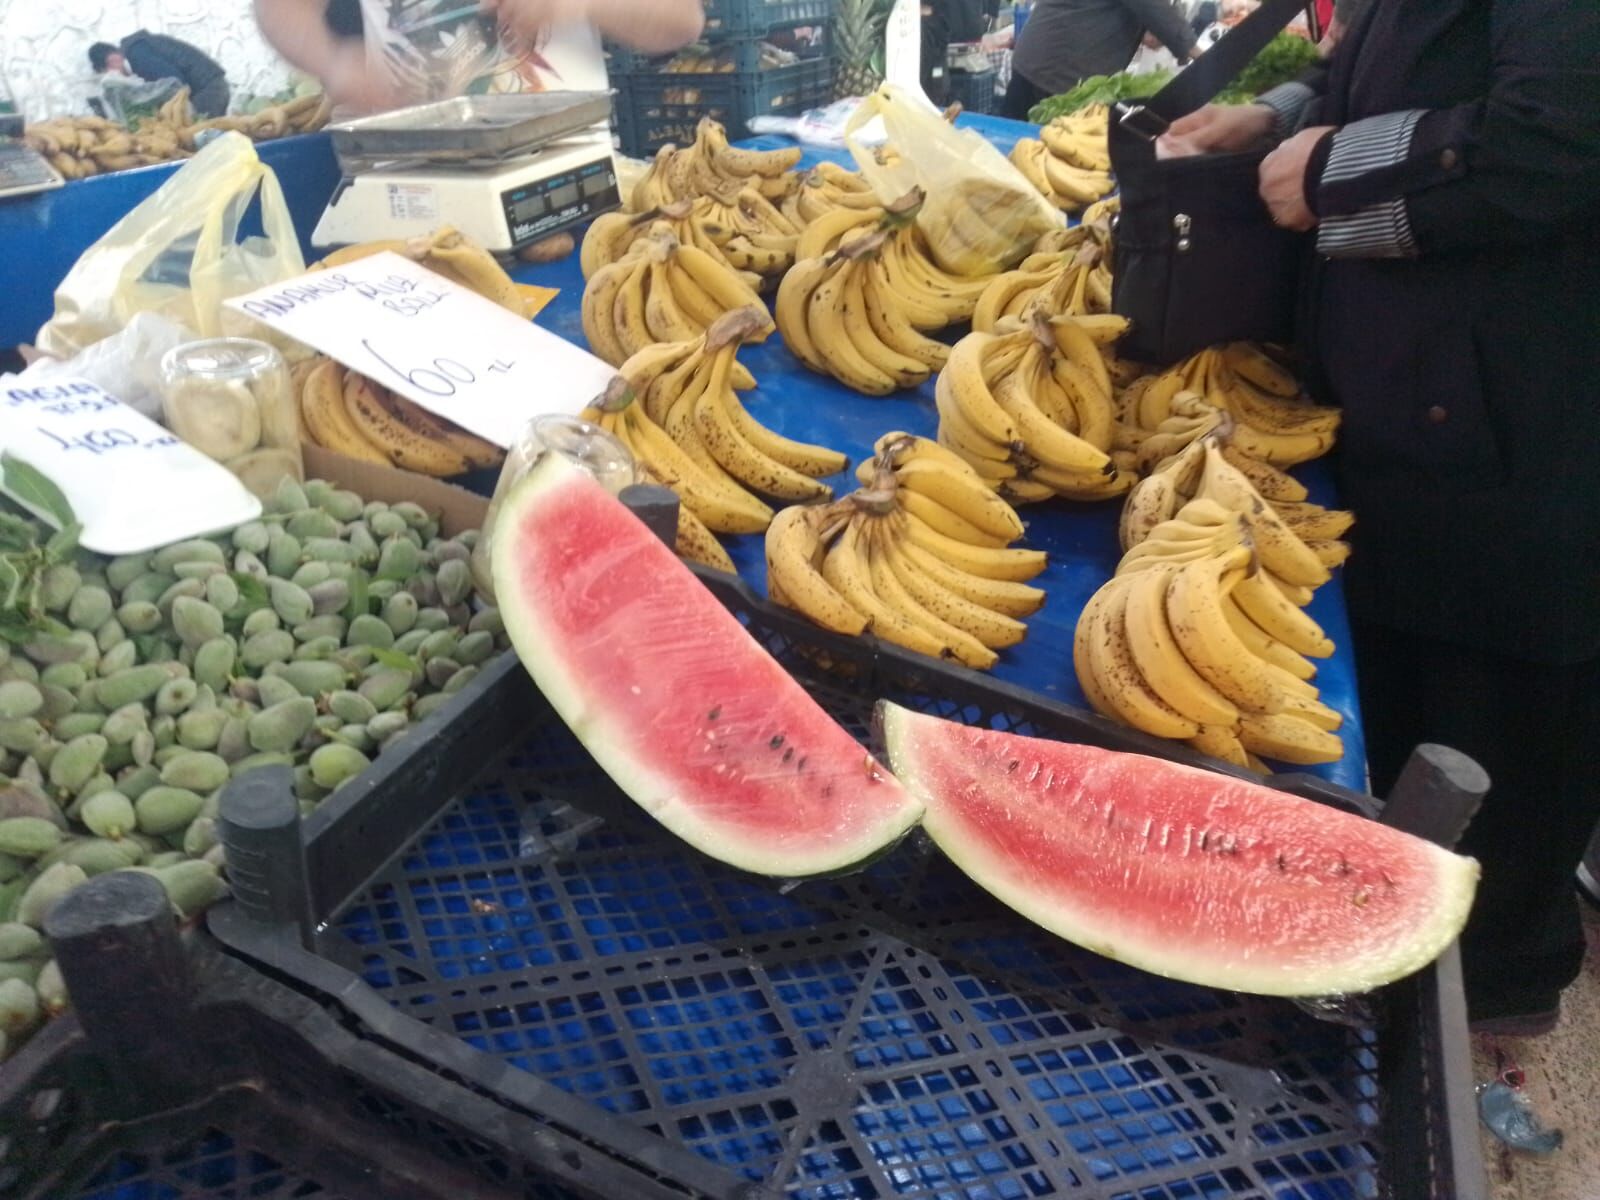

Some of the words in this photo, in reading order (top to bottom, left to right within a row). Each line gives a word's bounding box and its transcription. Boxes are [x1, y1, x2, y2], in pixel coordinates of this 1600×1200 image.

[243, 273, 366, 318] ANAMUR
[356, 274, 418, 300] MUZ
[361, 338, 476, 397] 60
[487, 357, 517, 375] TL
